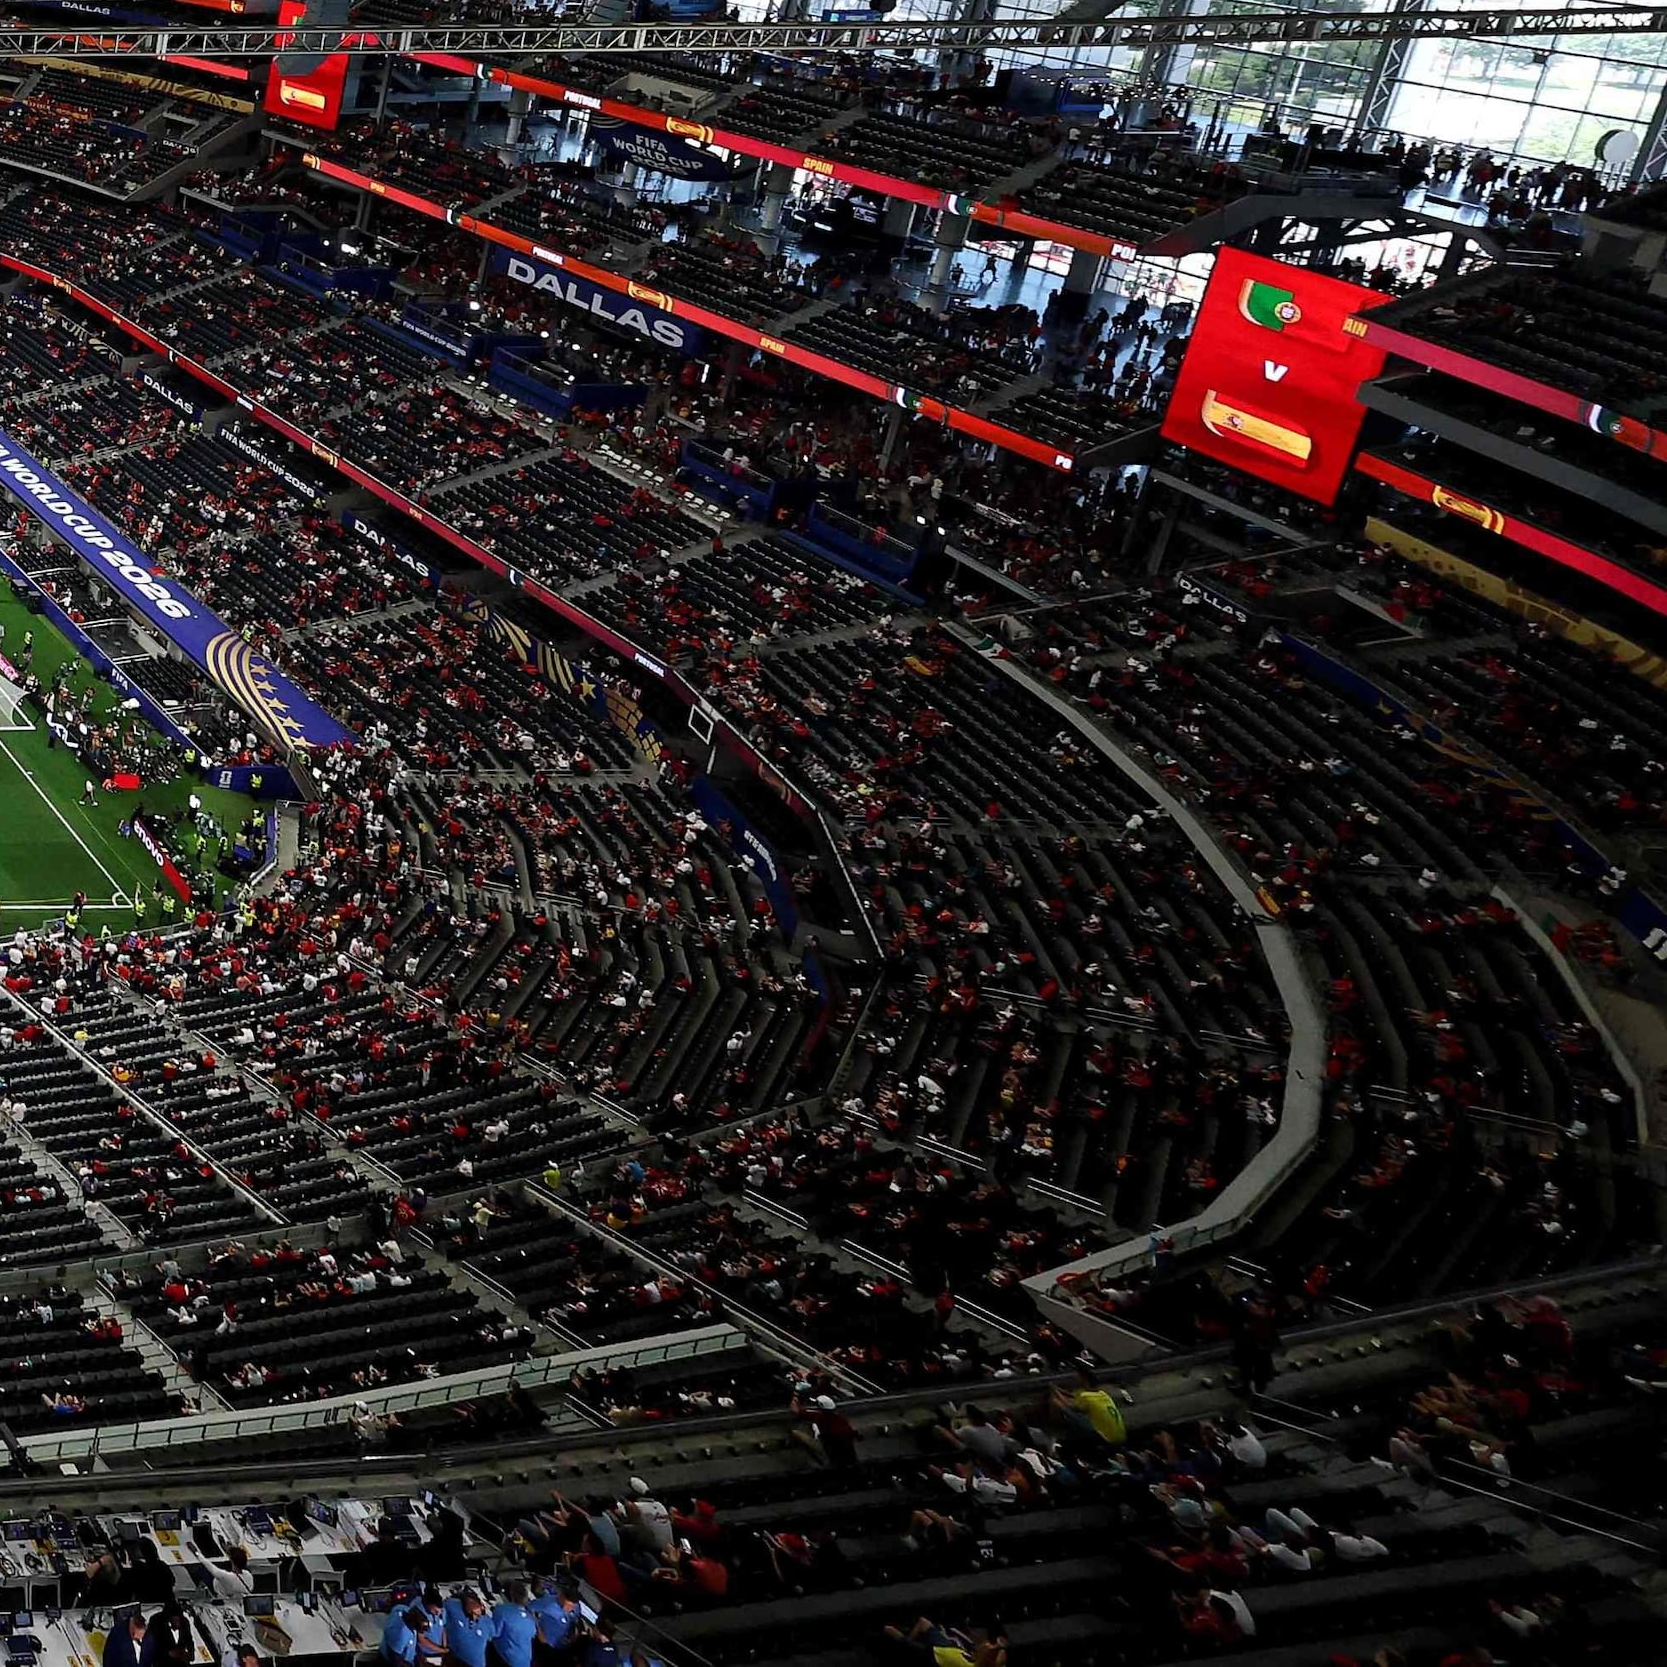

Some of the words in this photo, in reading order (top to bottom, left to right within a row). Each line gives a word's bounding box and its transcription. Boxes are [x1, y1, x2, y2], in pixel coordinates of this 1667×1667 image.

[62, 1, 111, 16] DALLAS
[612, 136, 671, 164] WORLD
[670, 153, 705, 173] CUP
[635, 134, 668, 153] FIFA
[803, 157, 834, 176] SPAIN
[507, 256, 685, 349] DALLAS
[144, 374, 197, 415] DALLAS
[220, 428, 241, 446] FIFA
[238, 440, 269, 466] WORLD
[267, 458, 287, 476] CUP
[283, 470, 317, 498] 2026
[0, 457, 75, 517] WORLD
[62, 513, 114, 550] CUP
[95, 550, 191, 620] 2026
[1179, 577, 1247, 623] DALLAS
[110, 667, 130, 692] FIFA
